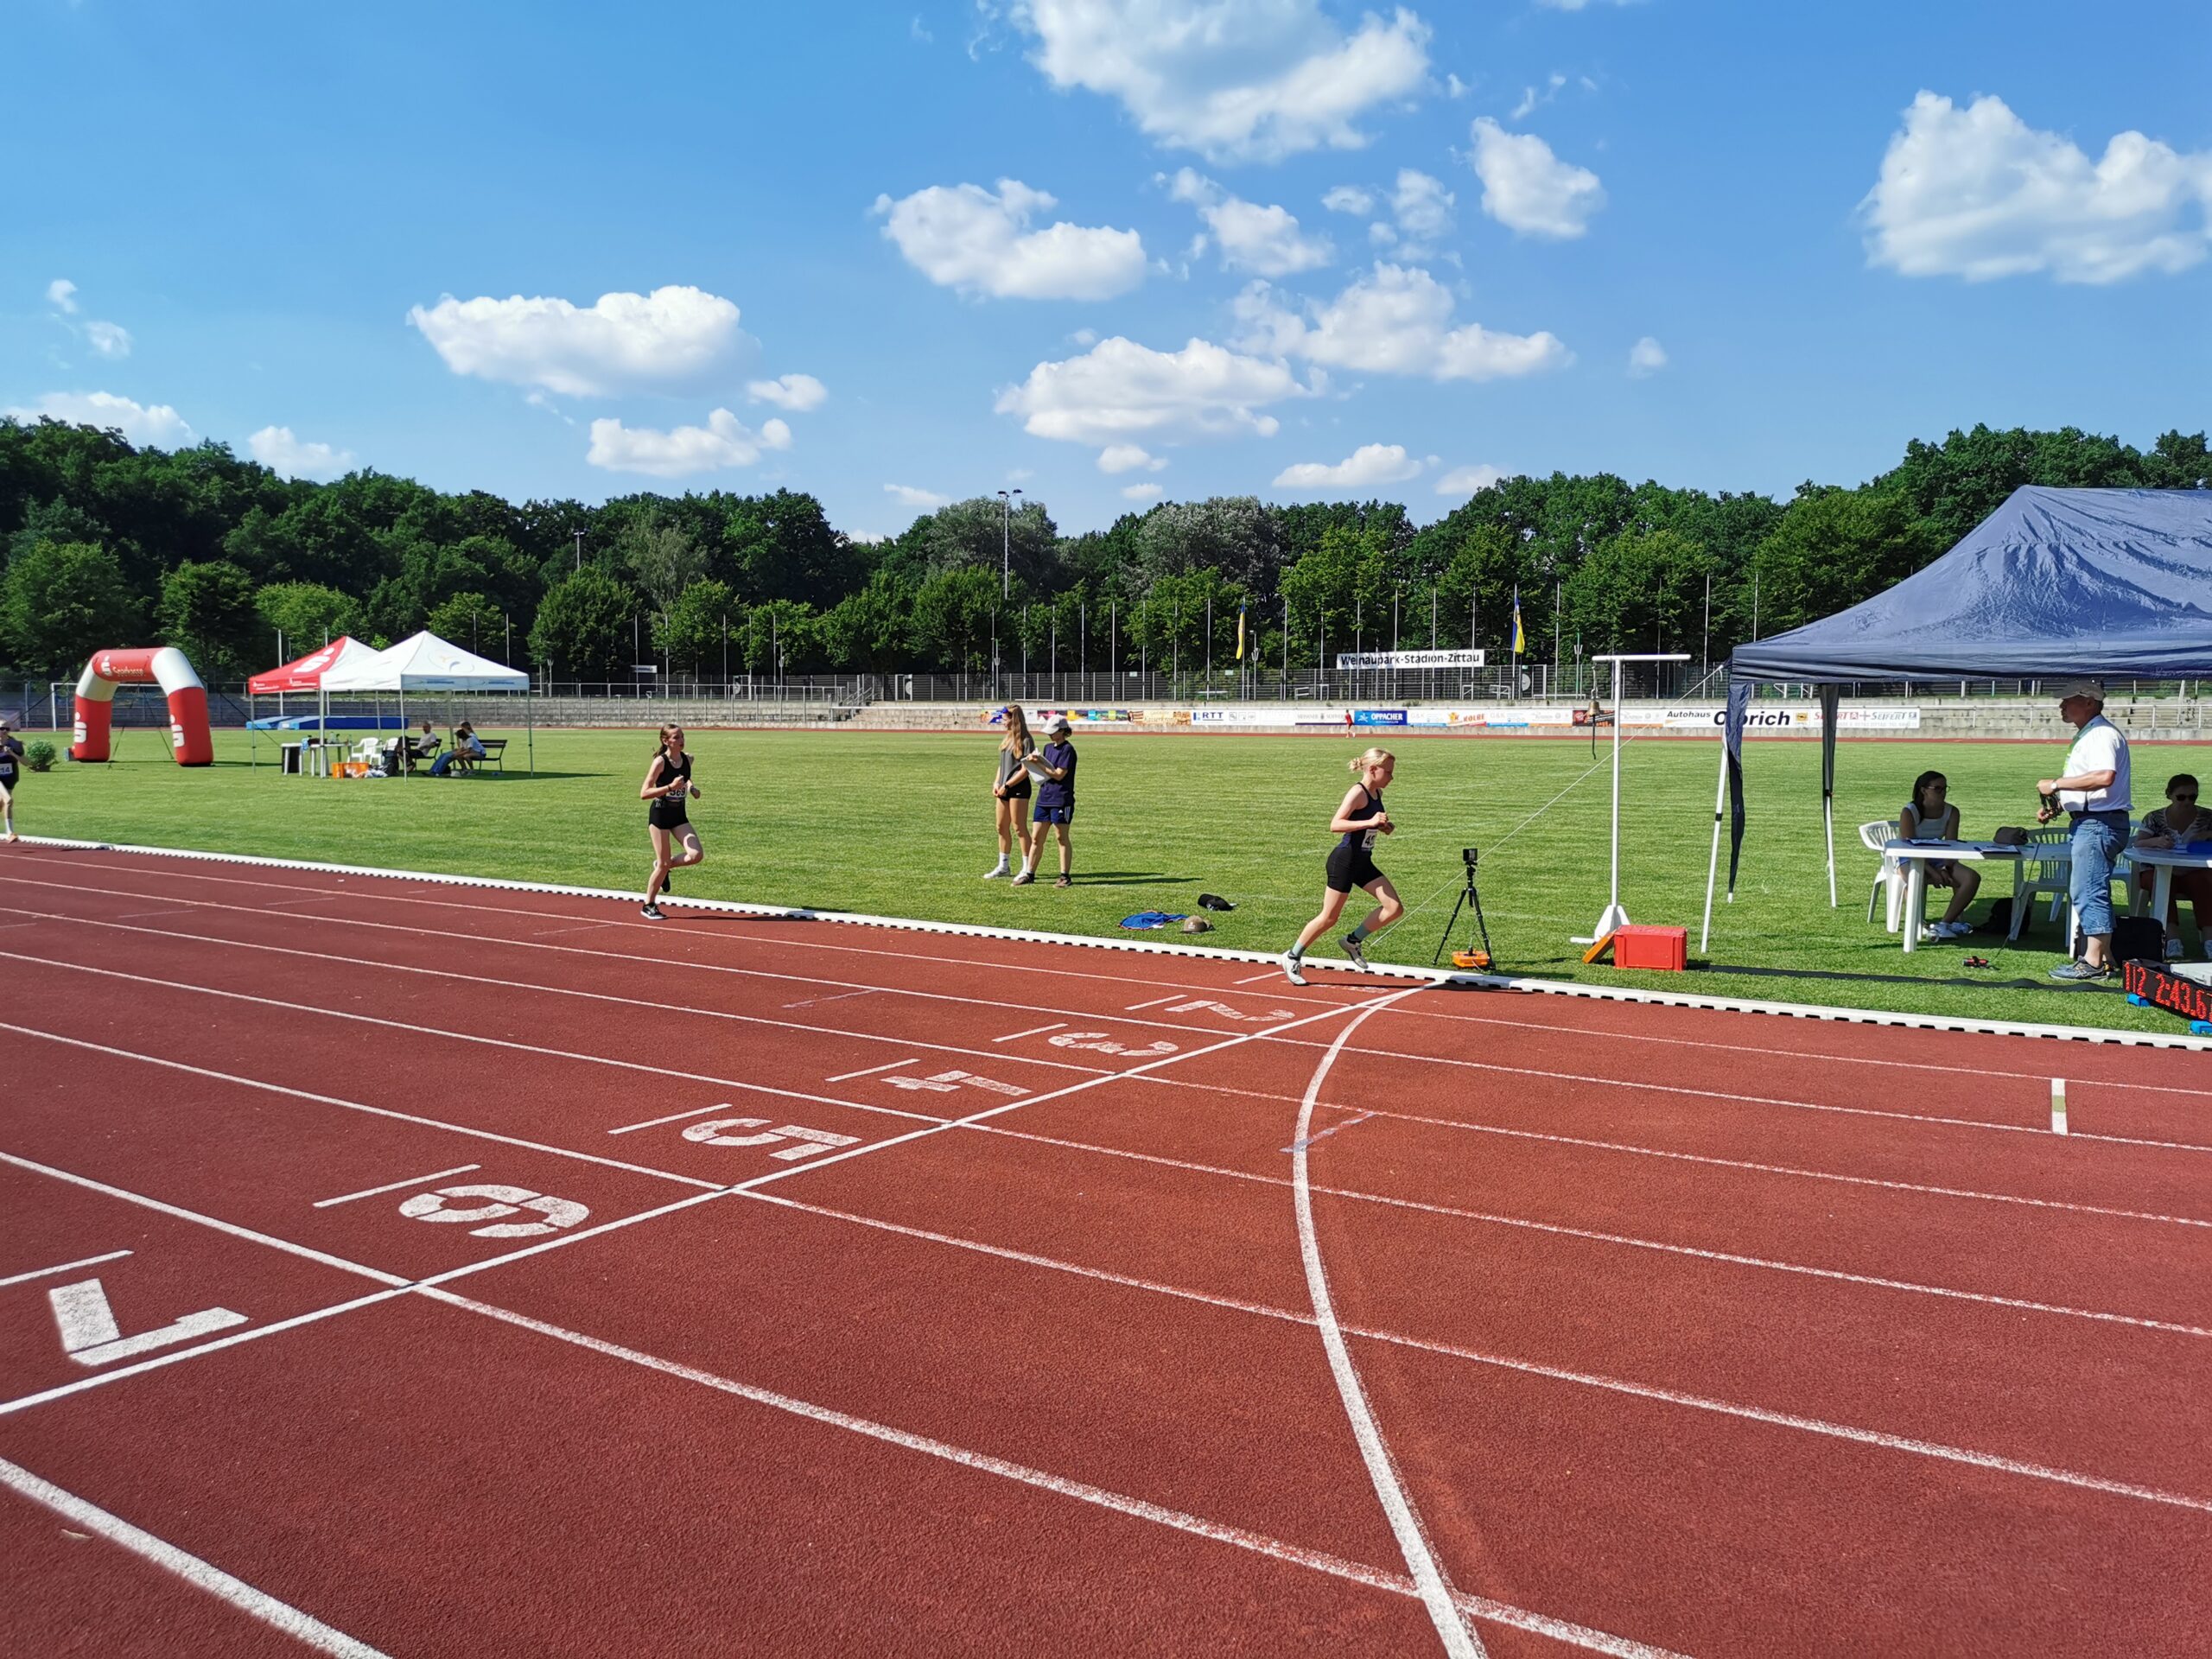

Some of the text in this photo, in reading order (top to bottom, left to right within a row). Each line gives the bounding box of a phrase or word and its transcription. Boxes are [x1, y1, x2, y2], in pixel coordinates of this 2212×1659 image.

[1667, 710, 1711, 719] Autohaus
[1046, 1031, 1179, 1057] 3
[881, 1070, 1031, 1096] 4
[682, 1117, 861, 1160] 5
[398, 1185, 590, 1238] 6
[48, 1277, 248, 1367] 7
